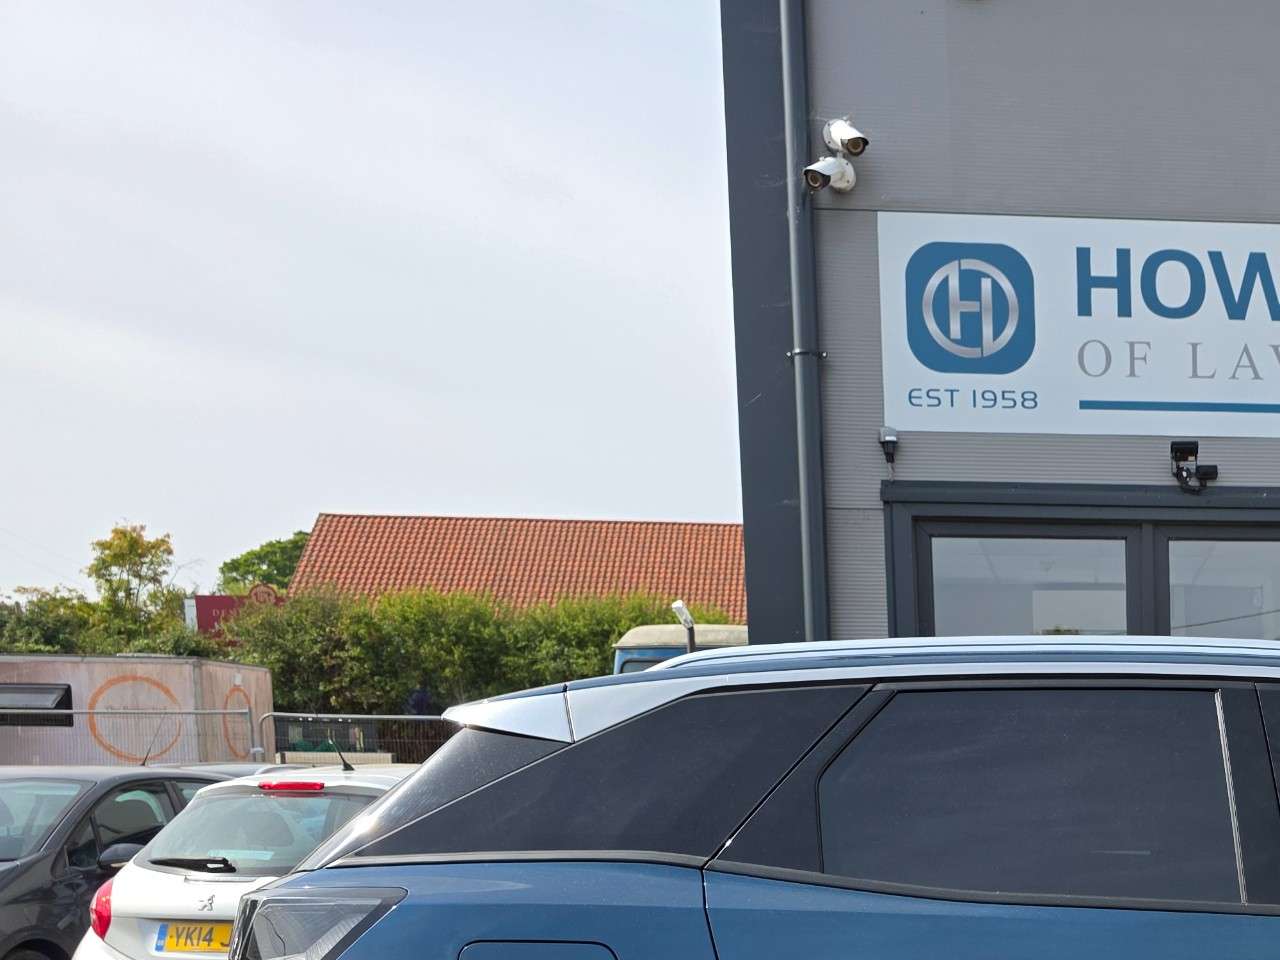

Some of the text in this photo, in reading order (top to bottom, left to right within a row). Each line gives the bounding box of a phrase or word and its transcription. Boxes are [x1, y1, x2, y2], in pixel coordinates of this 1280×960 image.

[1078, 339, 1152, 378] OF
[908, 388, 1038, 410] EST 1958
[175, 926, 214, 948] YK14
